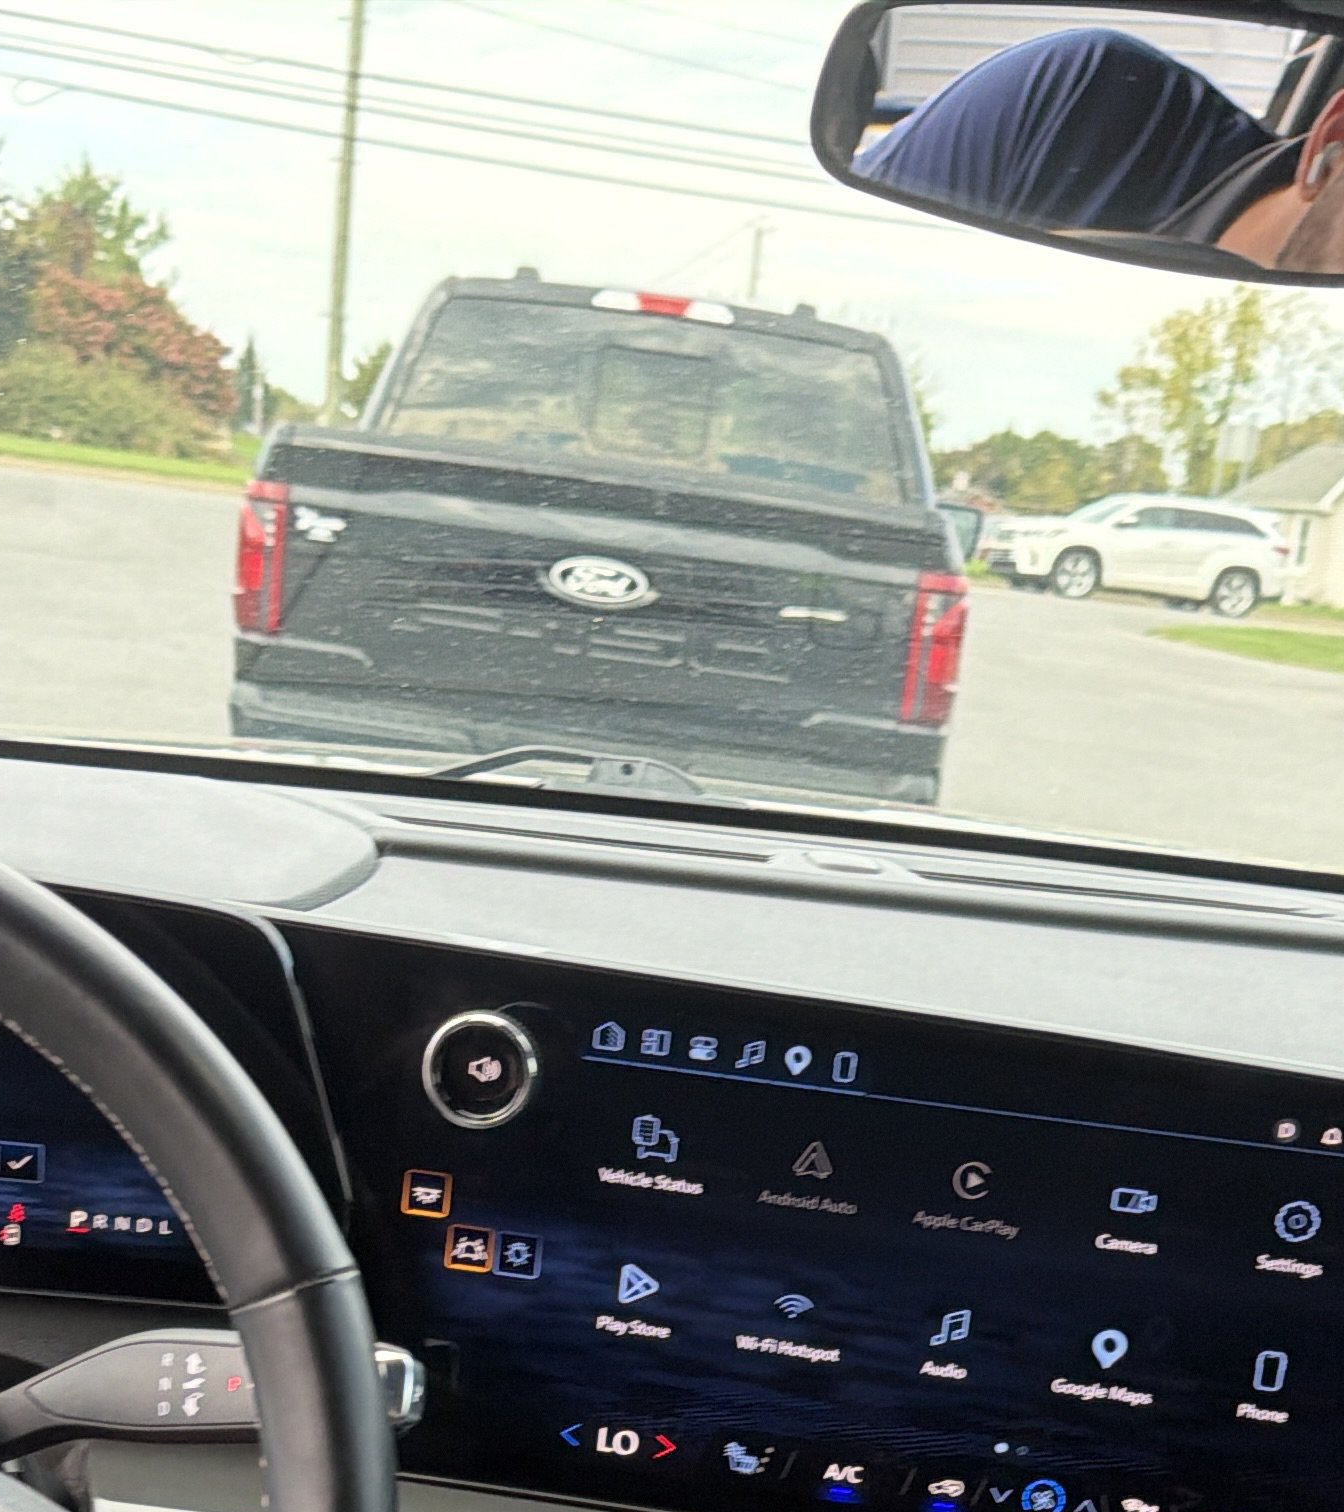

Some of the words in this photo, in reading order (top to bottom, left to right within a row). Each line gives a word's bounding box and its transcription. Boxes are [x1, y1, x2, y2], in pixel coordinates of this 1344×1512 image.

[597, 1166, 654, 1189] Vehicle
[652, 1175, 705, 1195] Status
[757, 1190, 819, 1211] Android
[817, 1198, 857, 1215] Auto
[912, 1210, 959, 1231] Apple
[959, 1216, 1021, 1240] CarPlay
[1094, 1233, 1159, 1256] Camera
[1255, 1253, 1324, 1280] Settings
[595, 1314, 630, 1337] Play
[629, 1320, 672, 1339] Store
[736, 1334, 778, 1354] Wi-Fi
[777, 1340, 841, 1364] Hotspot
[919, 1360, 969, 1381] Audio
[1050, 1378, 1110, 1401] Google
[1108, 1384, 1154, 1408] Maps
[1235, 1402, 1290, 1424] Phone
[595, 1426, 640, 1456] LO
[822, 1463, 865, 1485] A/C
